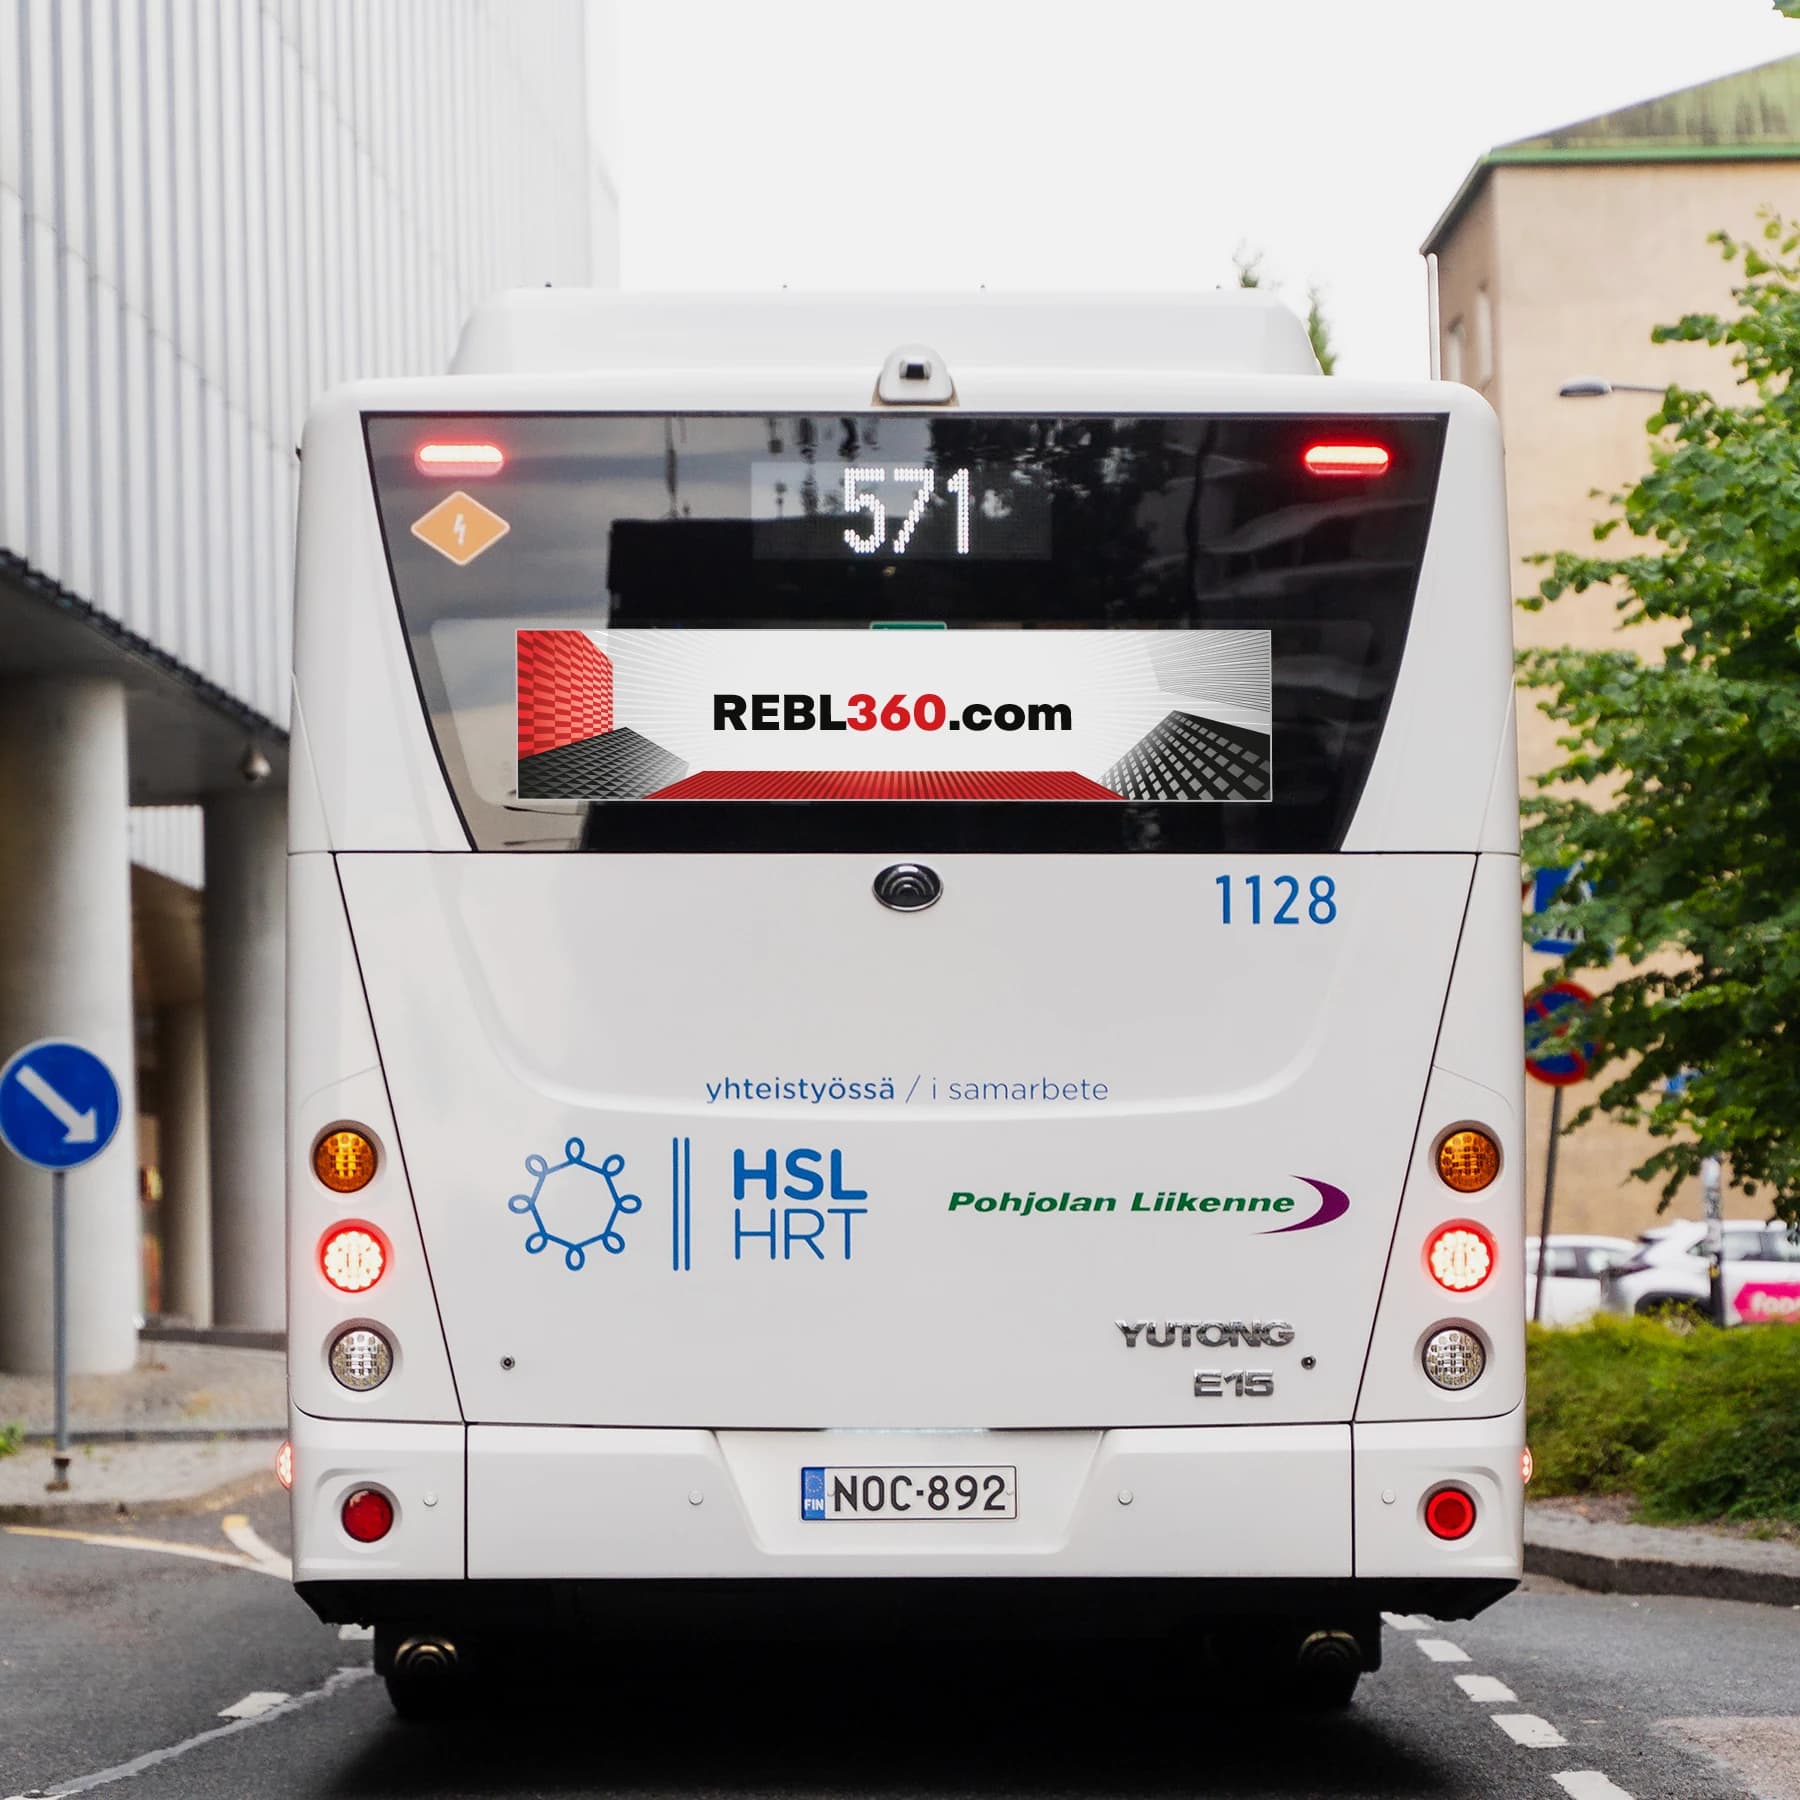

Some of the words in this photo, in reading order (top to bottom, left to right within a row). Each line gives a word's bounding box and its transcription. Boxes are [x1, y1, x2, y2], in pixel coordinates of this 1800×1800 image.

[844, 468, 970, 554] 571
[713, 694, 1072, 731] REBL360.com
[1215, 874, 1337, 925] 1128
[706, 1076, 895, 1104] yhteistyössä
[905, 1075, 921, 1104] /
[932, 1077, 937, 1099] i
[948, 1077, 1109, 1100] samarbete
[733, 1148, 868, 1201] HSL
[947, 1192, 1117, 1216] Pohjolan
[1130, 1192, 1296, 1213] Liikenne
[734, 1208, 868, 1260] HRT
[1114, 1320, 1295, 1348] YUTONG
[1194, 1369, 1275, 1397] E15
[804, 1499, 824, 1511] FIN
[834, 1475, 1006, 1512] NOC-892
